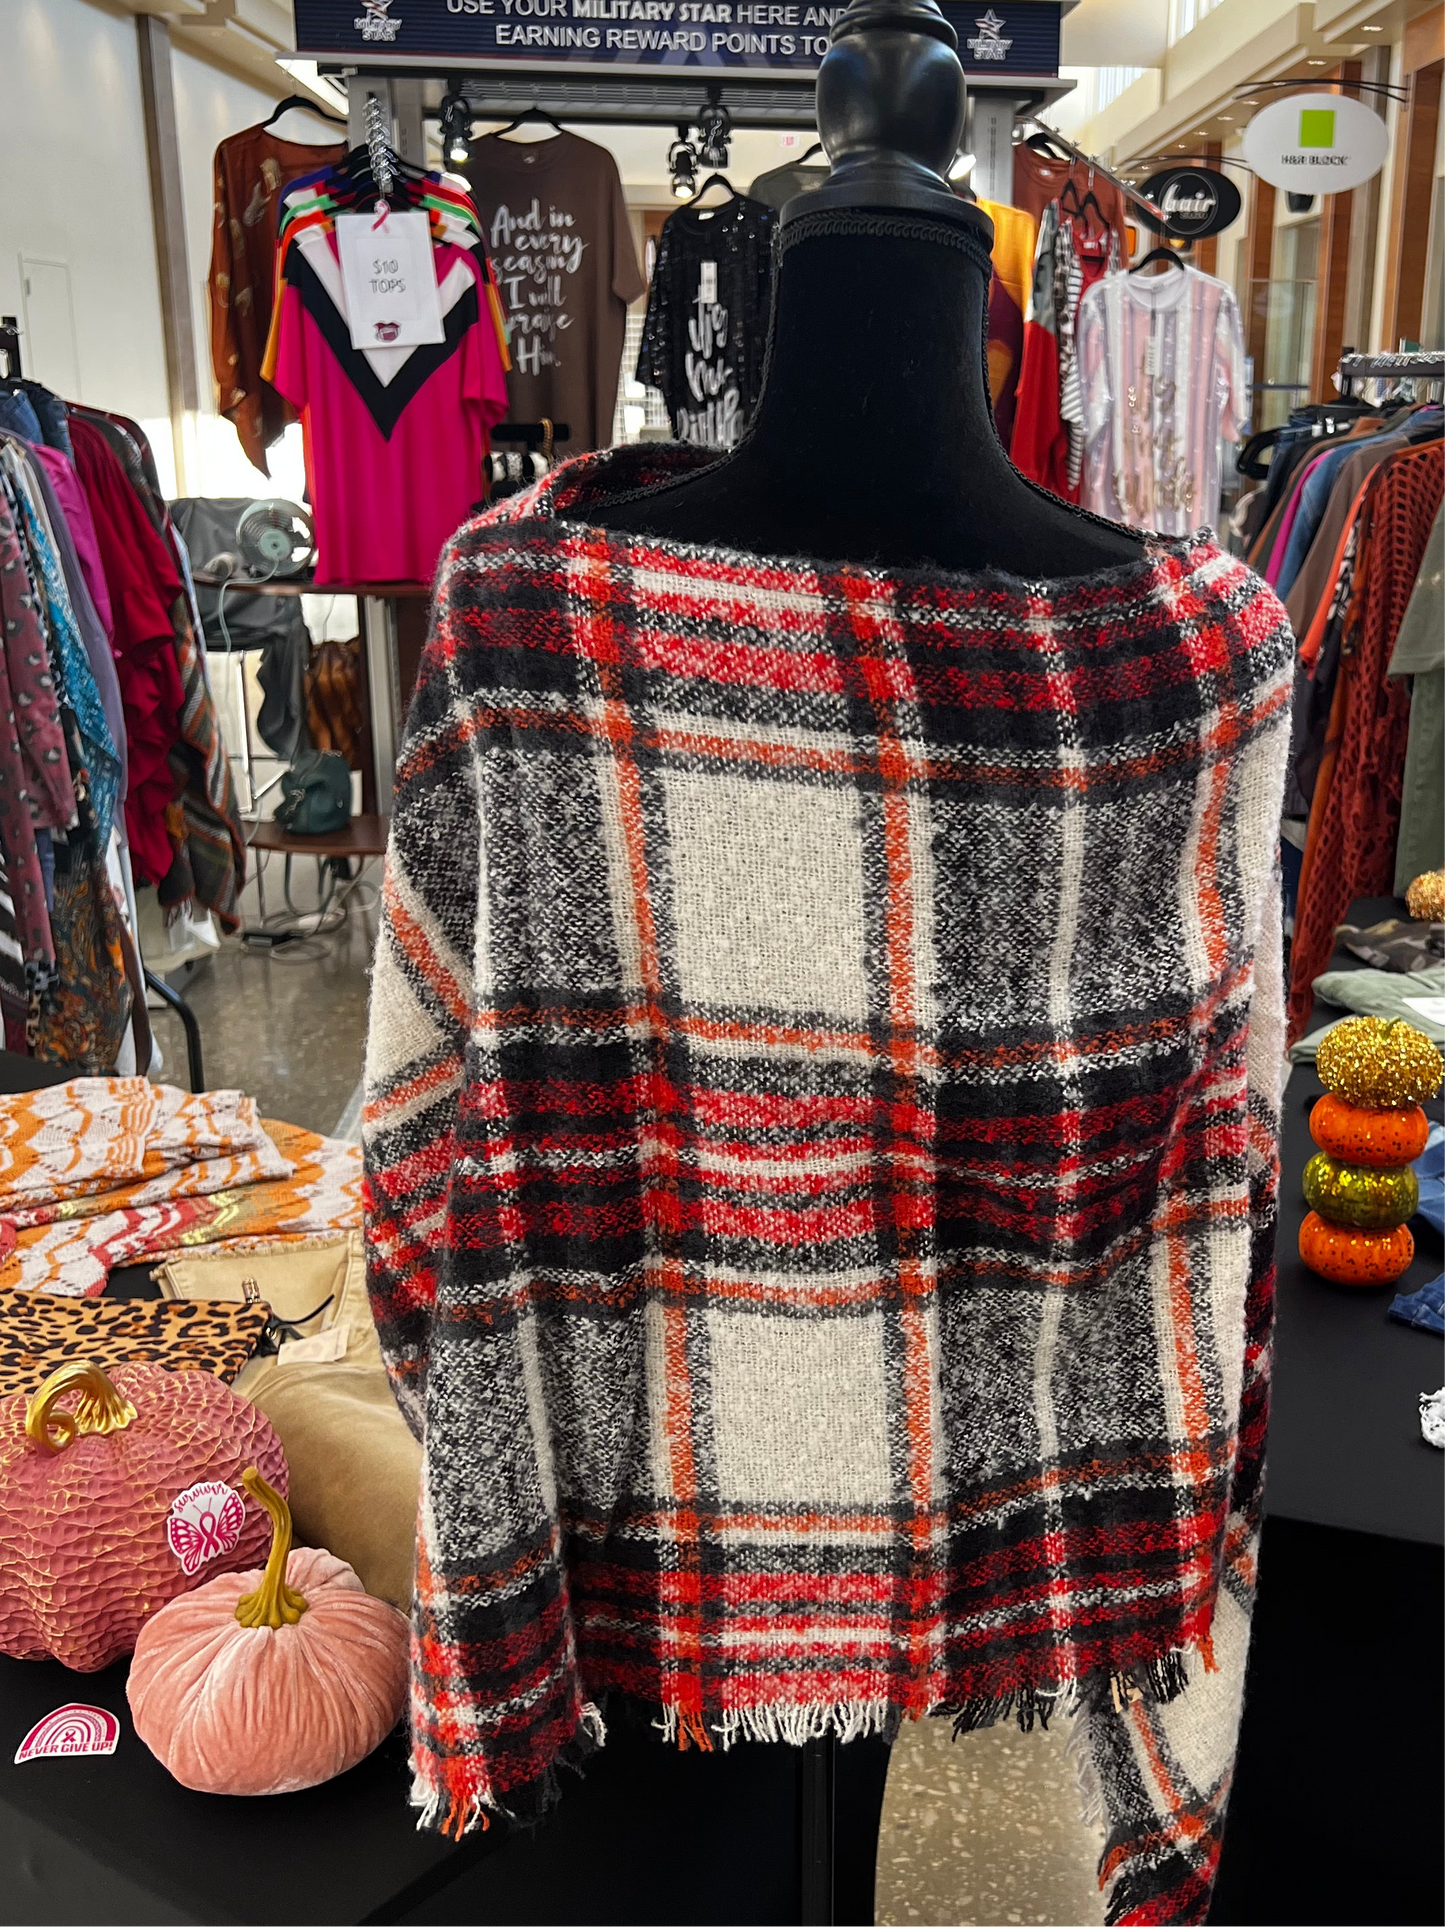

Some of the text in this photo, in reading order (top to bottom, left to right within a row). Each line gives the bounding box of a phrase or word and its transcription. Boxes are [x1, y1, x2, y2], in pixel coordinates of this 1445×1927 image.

[447, 0, 495, 14] USE
[502, 0, 568, 17] YOUR
[572, 0, 675, 21] MILITARY
[679, 3, 733, 23] STAR
[737, 5, 800, 25] HERE
[362, 28, 397, 41] STAR
[495, 24, 831, 56] EARNING REWARD POINTS TO
[974, 47, 1006, 60] STAR
[1160, 183, 1217, 213] hair
[490, 197, 577, 249] And in
[372, 259, 399, 275] $10
[514, 233, 590, 274] every
[368, 278, 406, 294] TOPS
[503, 274, 527, 310] I
[174, 1482, 228, 1514] survivor
[18, 1740, 114, 1761] NEVER GIVE UP!
